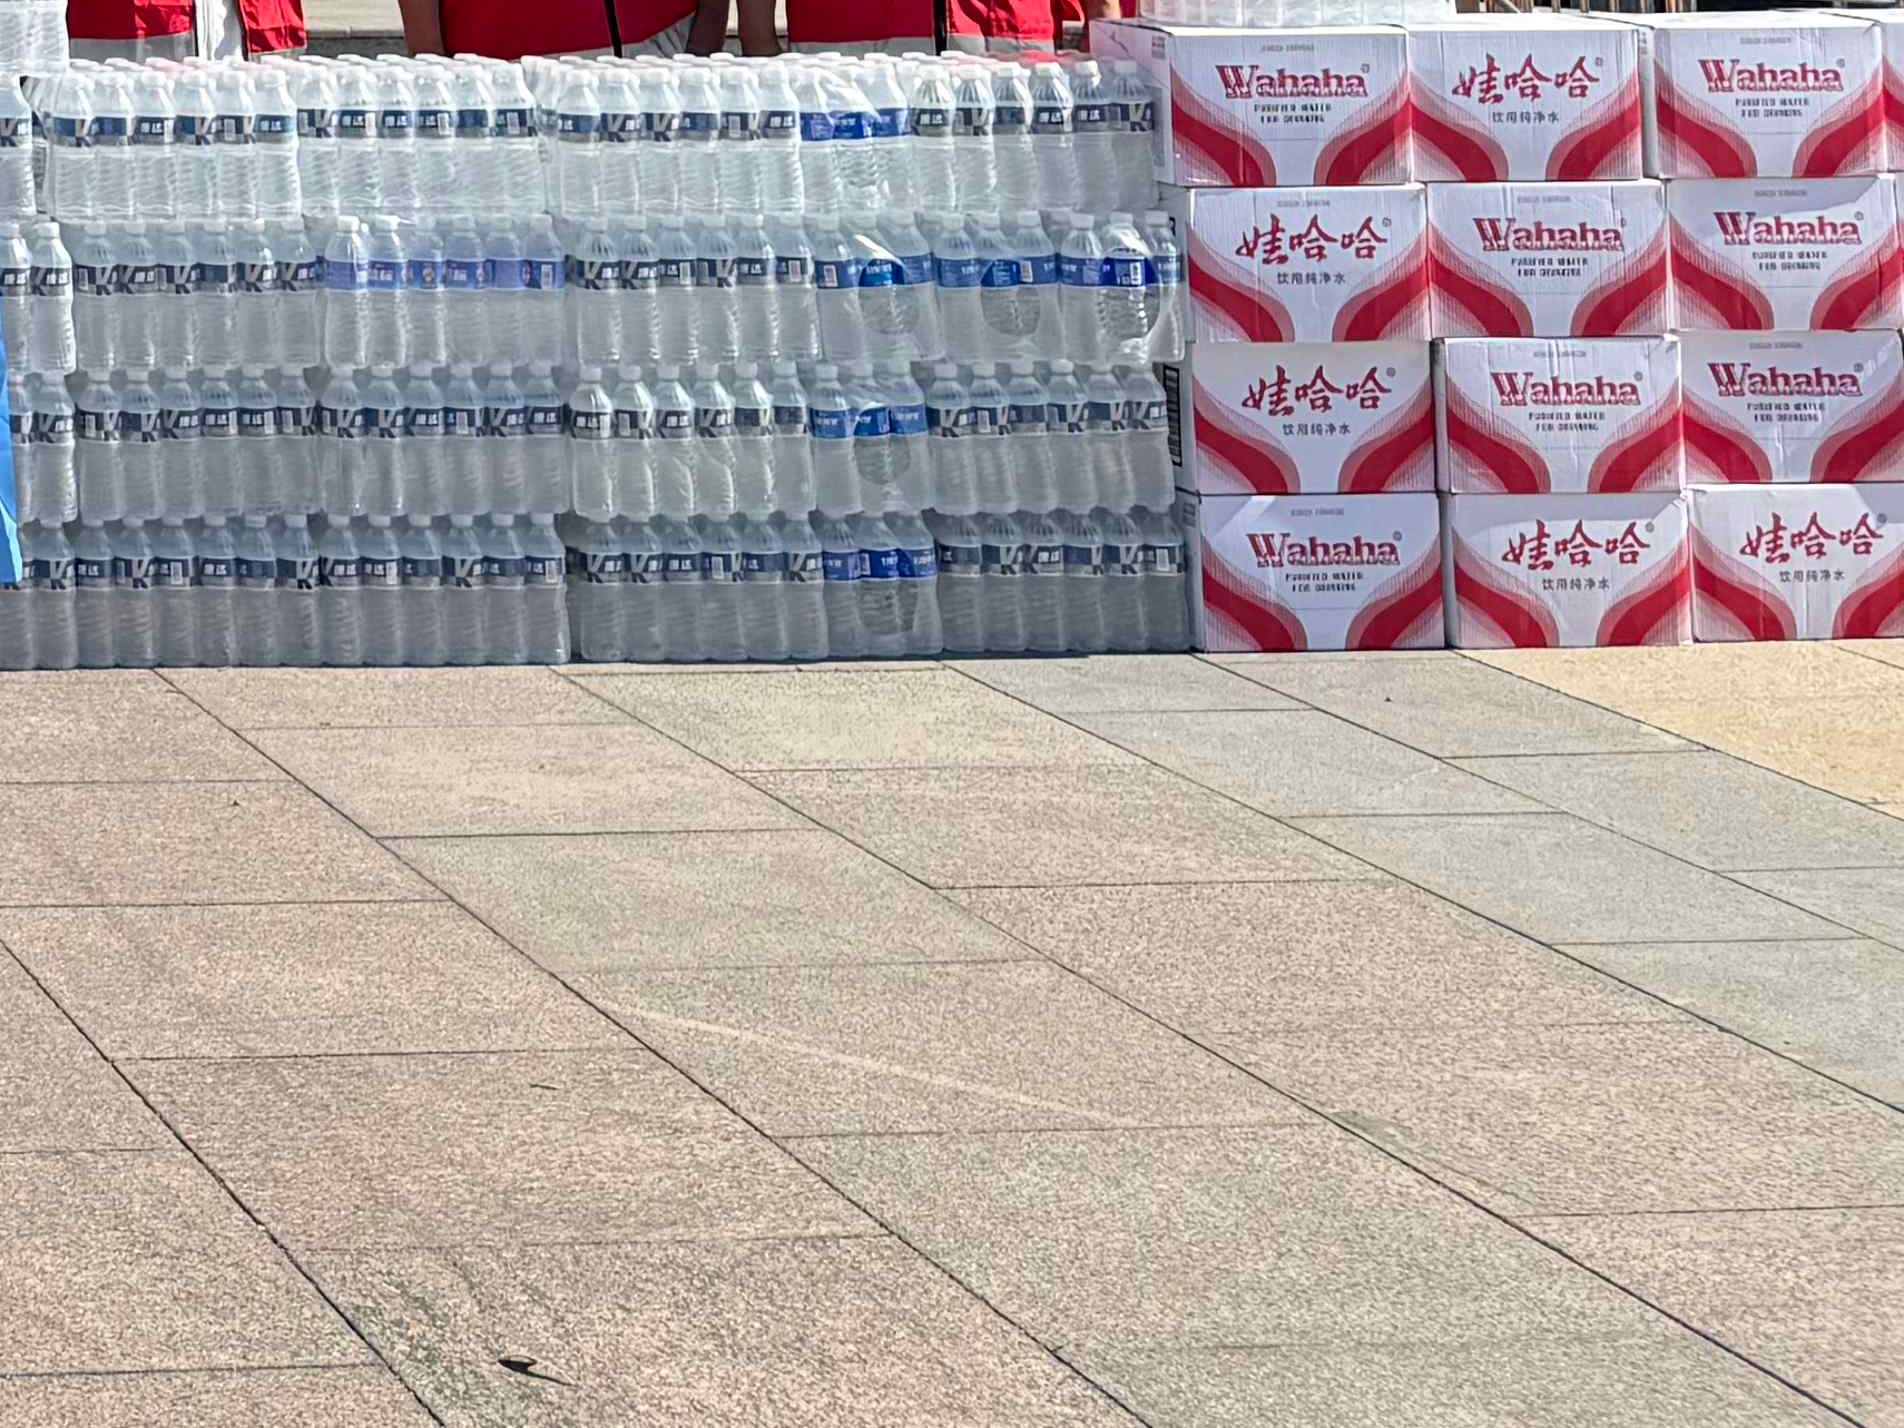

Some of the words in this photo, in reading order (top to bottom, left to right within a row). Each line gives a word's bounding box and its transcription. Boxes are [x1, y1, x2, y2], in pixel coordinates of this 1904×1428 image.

[1216, 65, 1368, 99] Wahaha
[1452, 52, 1599, 104] 娃哈哈
[1698, 59, 1843, 92] Wahaha
[1492, 111, 1560, 124] 饮用纯净水
[1235, 213, 1388, 264] 娃哈哈
[1473, 218, 1624, 252] Wahaha
[1713, 212, 1862, 245] Wahaha
[1277, 272, 1346, 285] 饮用纯净水
[1242, 364, 1392, 416] 娃哈哈
[1491, 372, 1640, 406] Wahaha
[1707, 363, 1863, 397] Wahaha
[1282, 423, 1351, 436] 饮用纯净水
[1246, 533, 1400, 568] Wahaha
[1502, 519, 1650, 570] 娃哈哈
[1739, 512, 1883, 563] 娃哈哈
[1542, 577, 1610, 591] 饮用纯净水
[1779, 569, 1845, 583] 饮用纯净水
